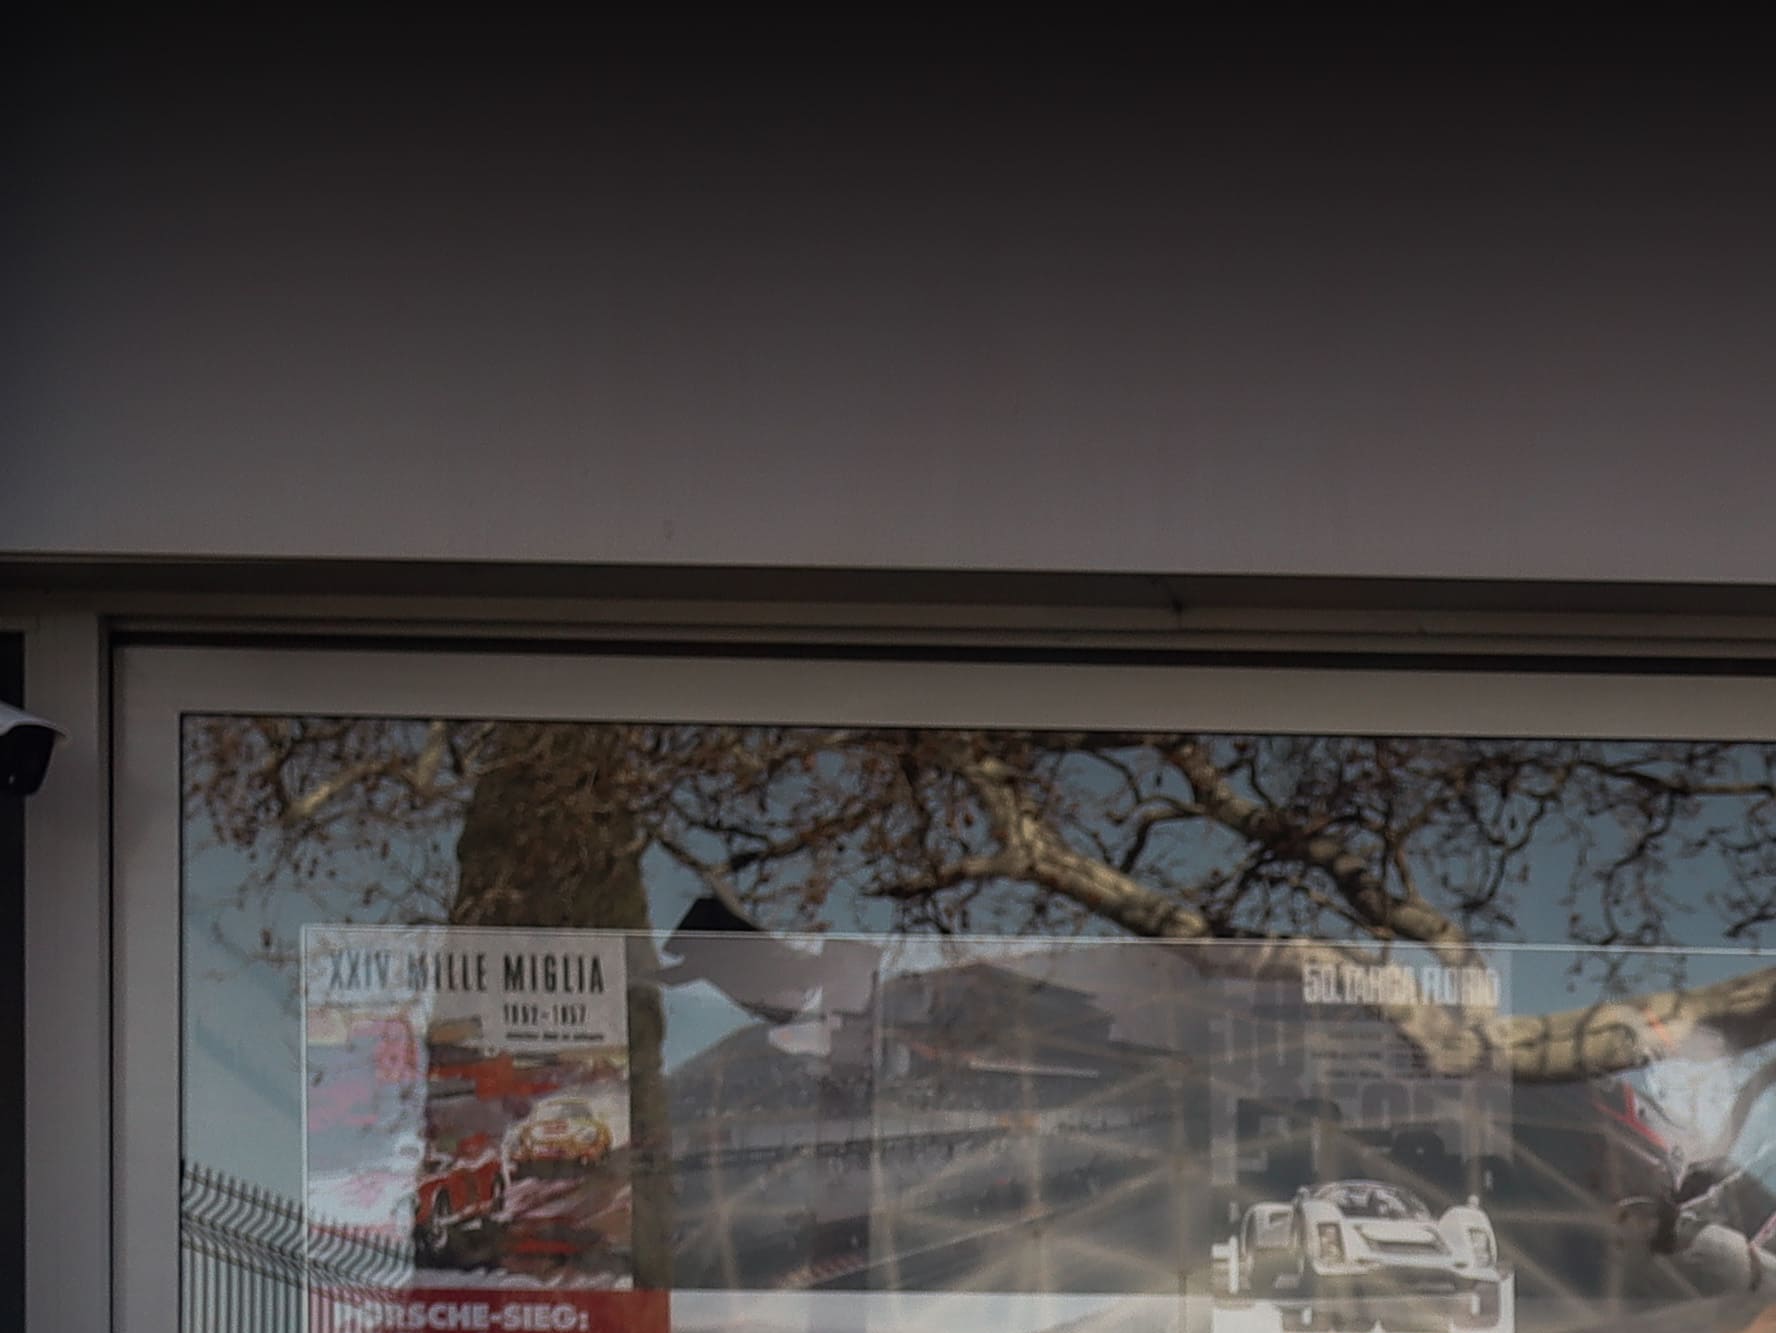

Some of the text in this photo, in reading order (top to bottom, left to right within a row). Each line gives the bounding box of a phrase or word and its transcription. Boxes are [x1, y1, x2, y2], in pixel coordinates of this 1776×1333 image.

[407, 951, 487, 992] MILLE
[503, 953, 604, 993] MIGLIA
[333, 1300, 591, 1332] PORSCHE-SIEG:
